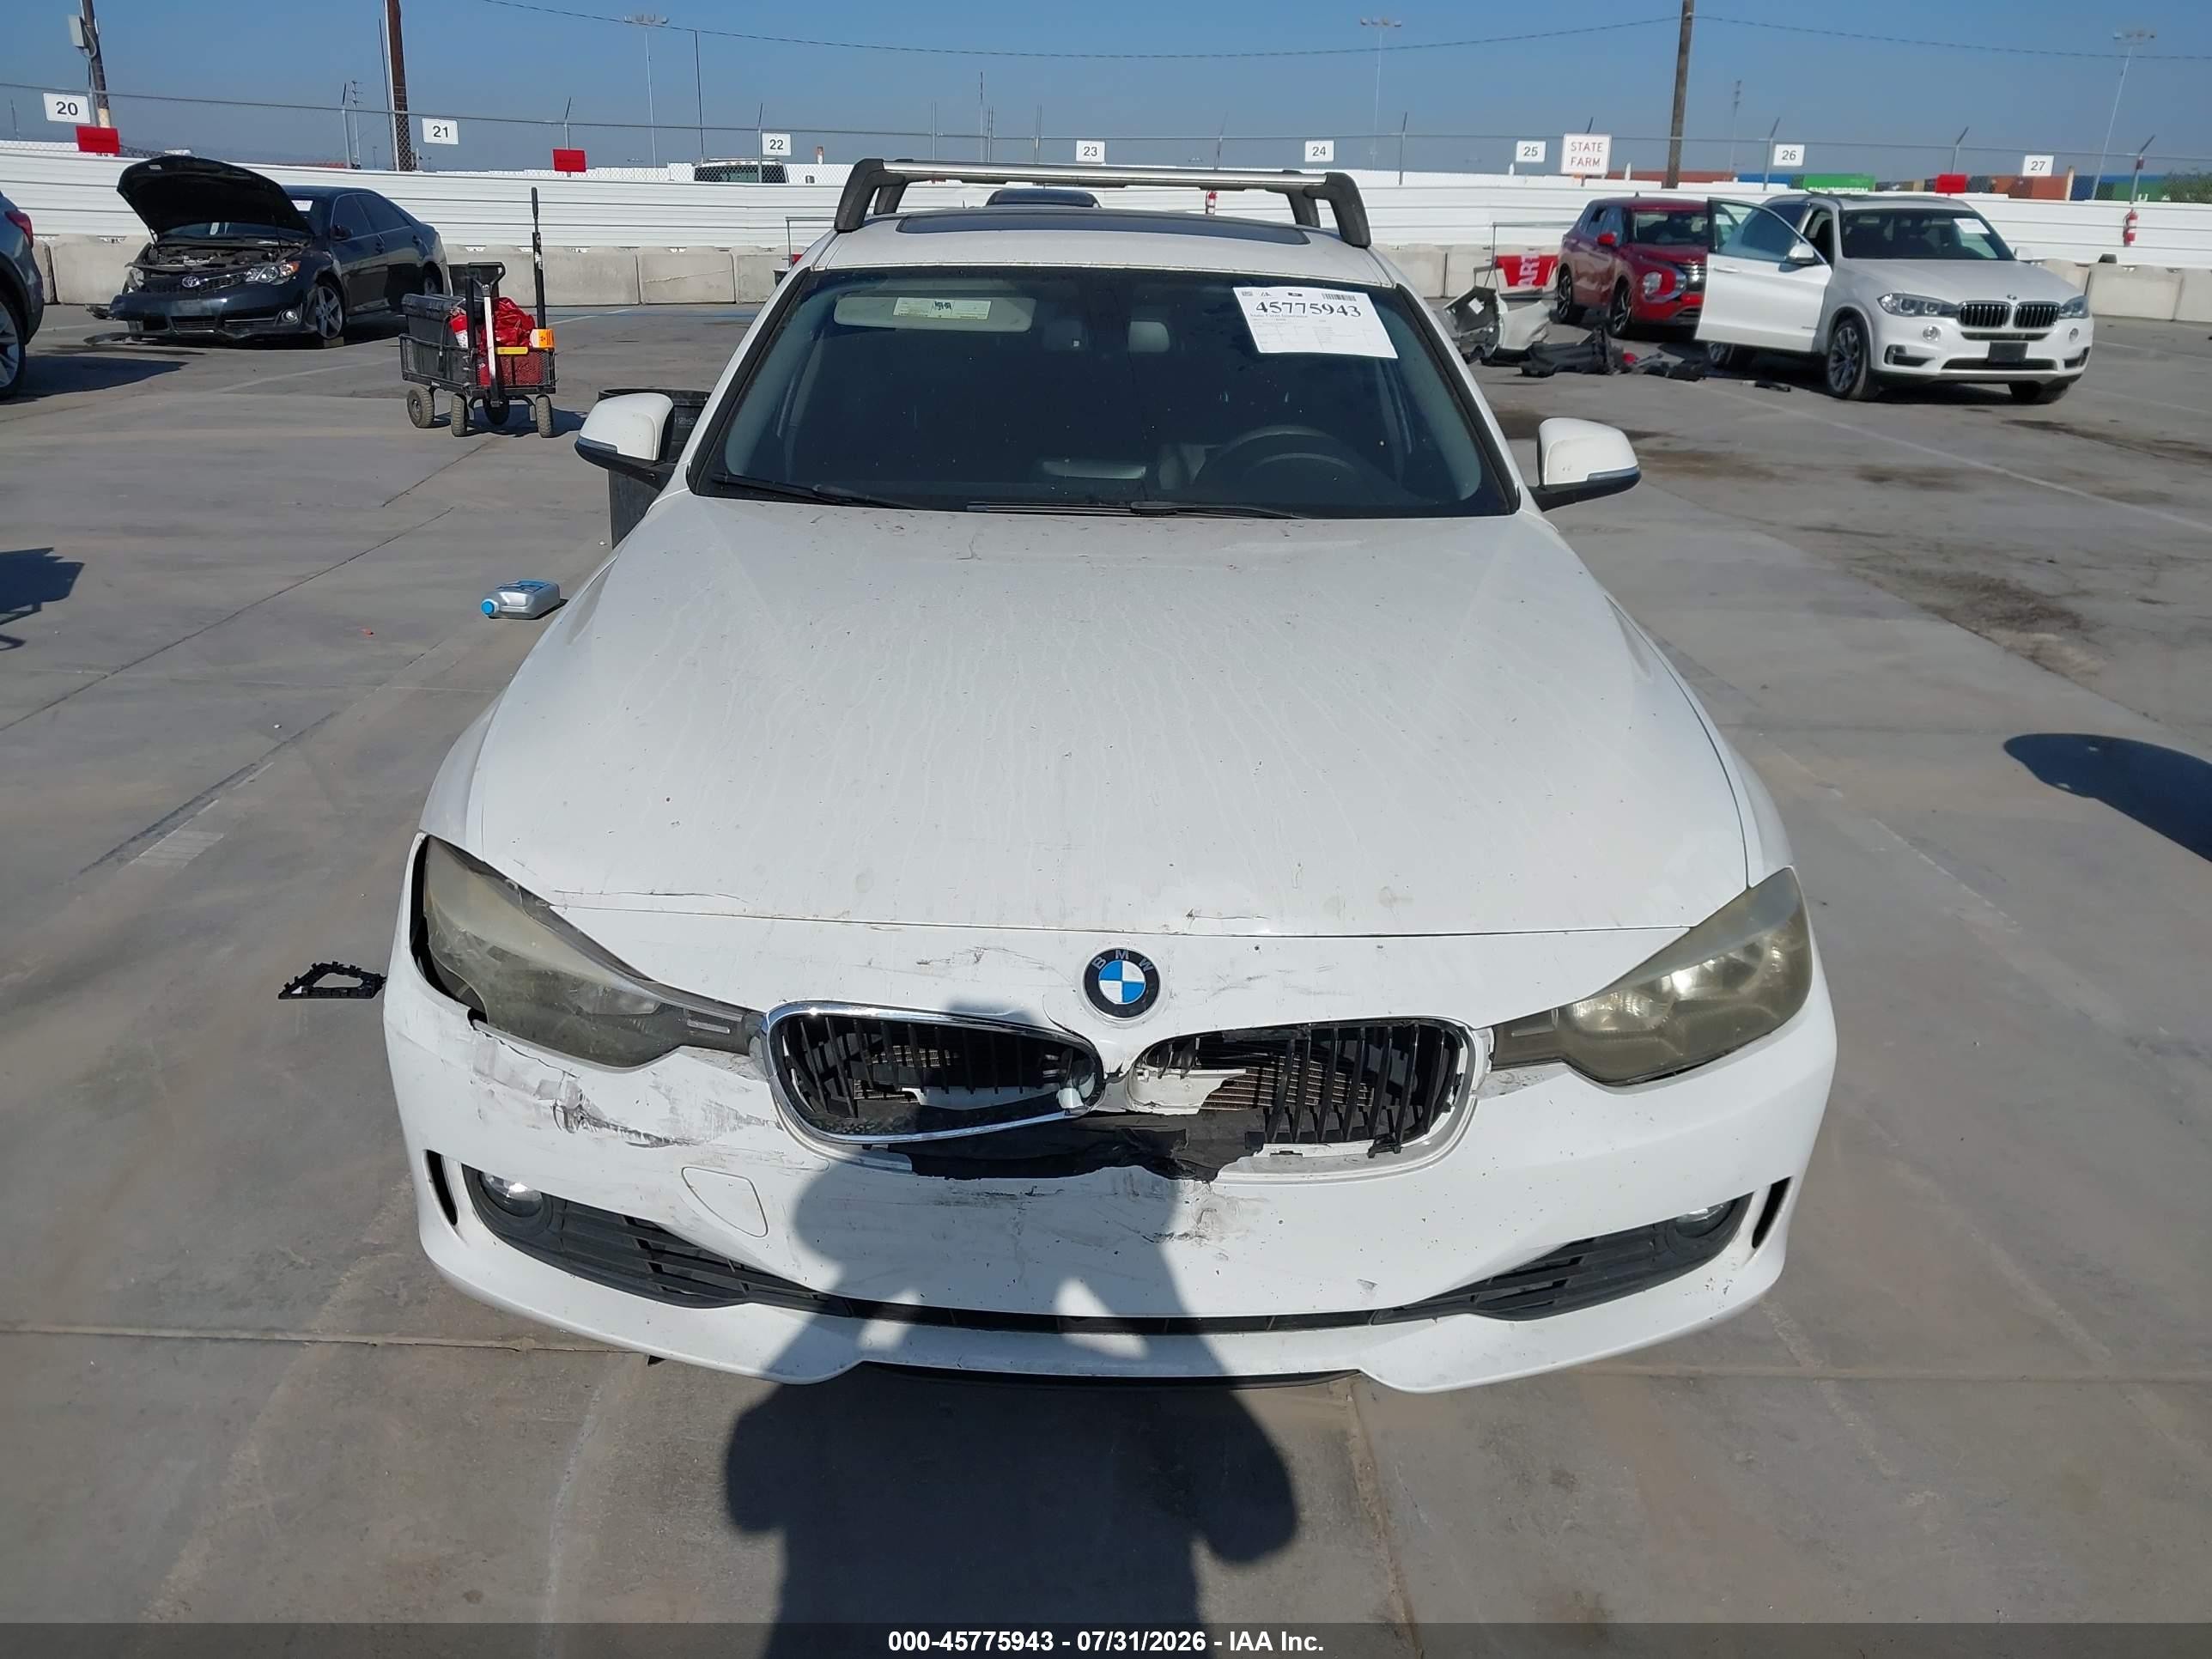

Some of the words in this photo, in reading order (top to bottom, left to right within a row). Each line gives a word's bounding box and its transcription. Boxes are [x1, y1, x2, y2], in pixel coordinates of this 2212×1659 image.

[56, 101, 78, 116] 20
[432, 125, 448, 138] 21
[769, 138, 784, 150] 22
[1571, 142, 1603, 152] STATE
[1084, 146, 1097, 157] 23
[1312, 146, 1326, 157] 24
[1523, 146, 1538, 157] 25
[1781, 149, 1796, 161] 26
[1571, 156, 1601, 167] FARM
[2030, 161, 2046, 172] 27
[1255, 301, 1362, 318] 45775943
[1091, 950, 1154, 973] BMW
